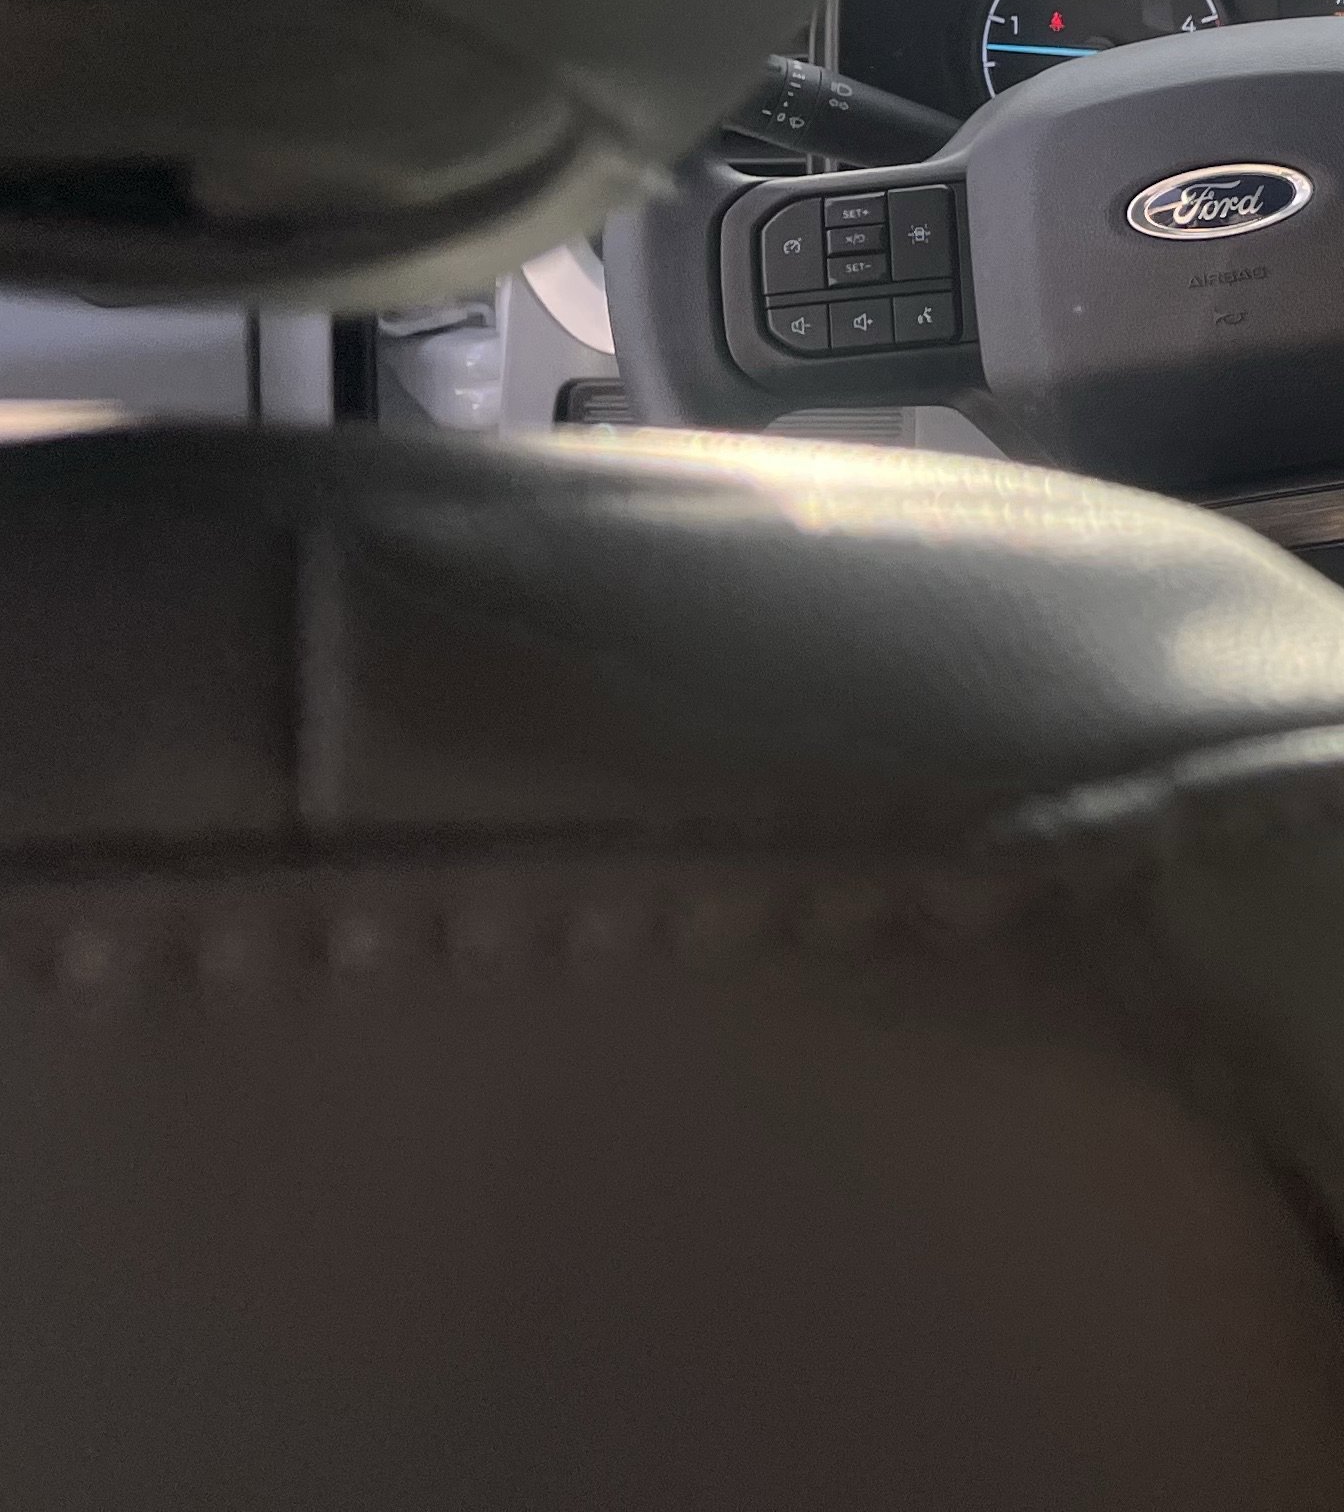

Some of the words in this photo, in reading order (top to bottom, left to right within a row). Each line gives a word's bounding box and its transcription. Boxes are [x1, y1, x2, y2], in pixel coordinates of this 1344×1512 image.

[1010, 15, 1018, 34] 1
[1181, 15, 1196, 33] 4
[1173, 179, 1265, 225] Ford
[1188, 266, 1267, 288] AIRBAG
